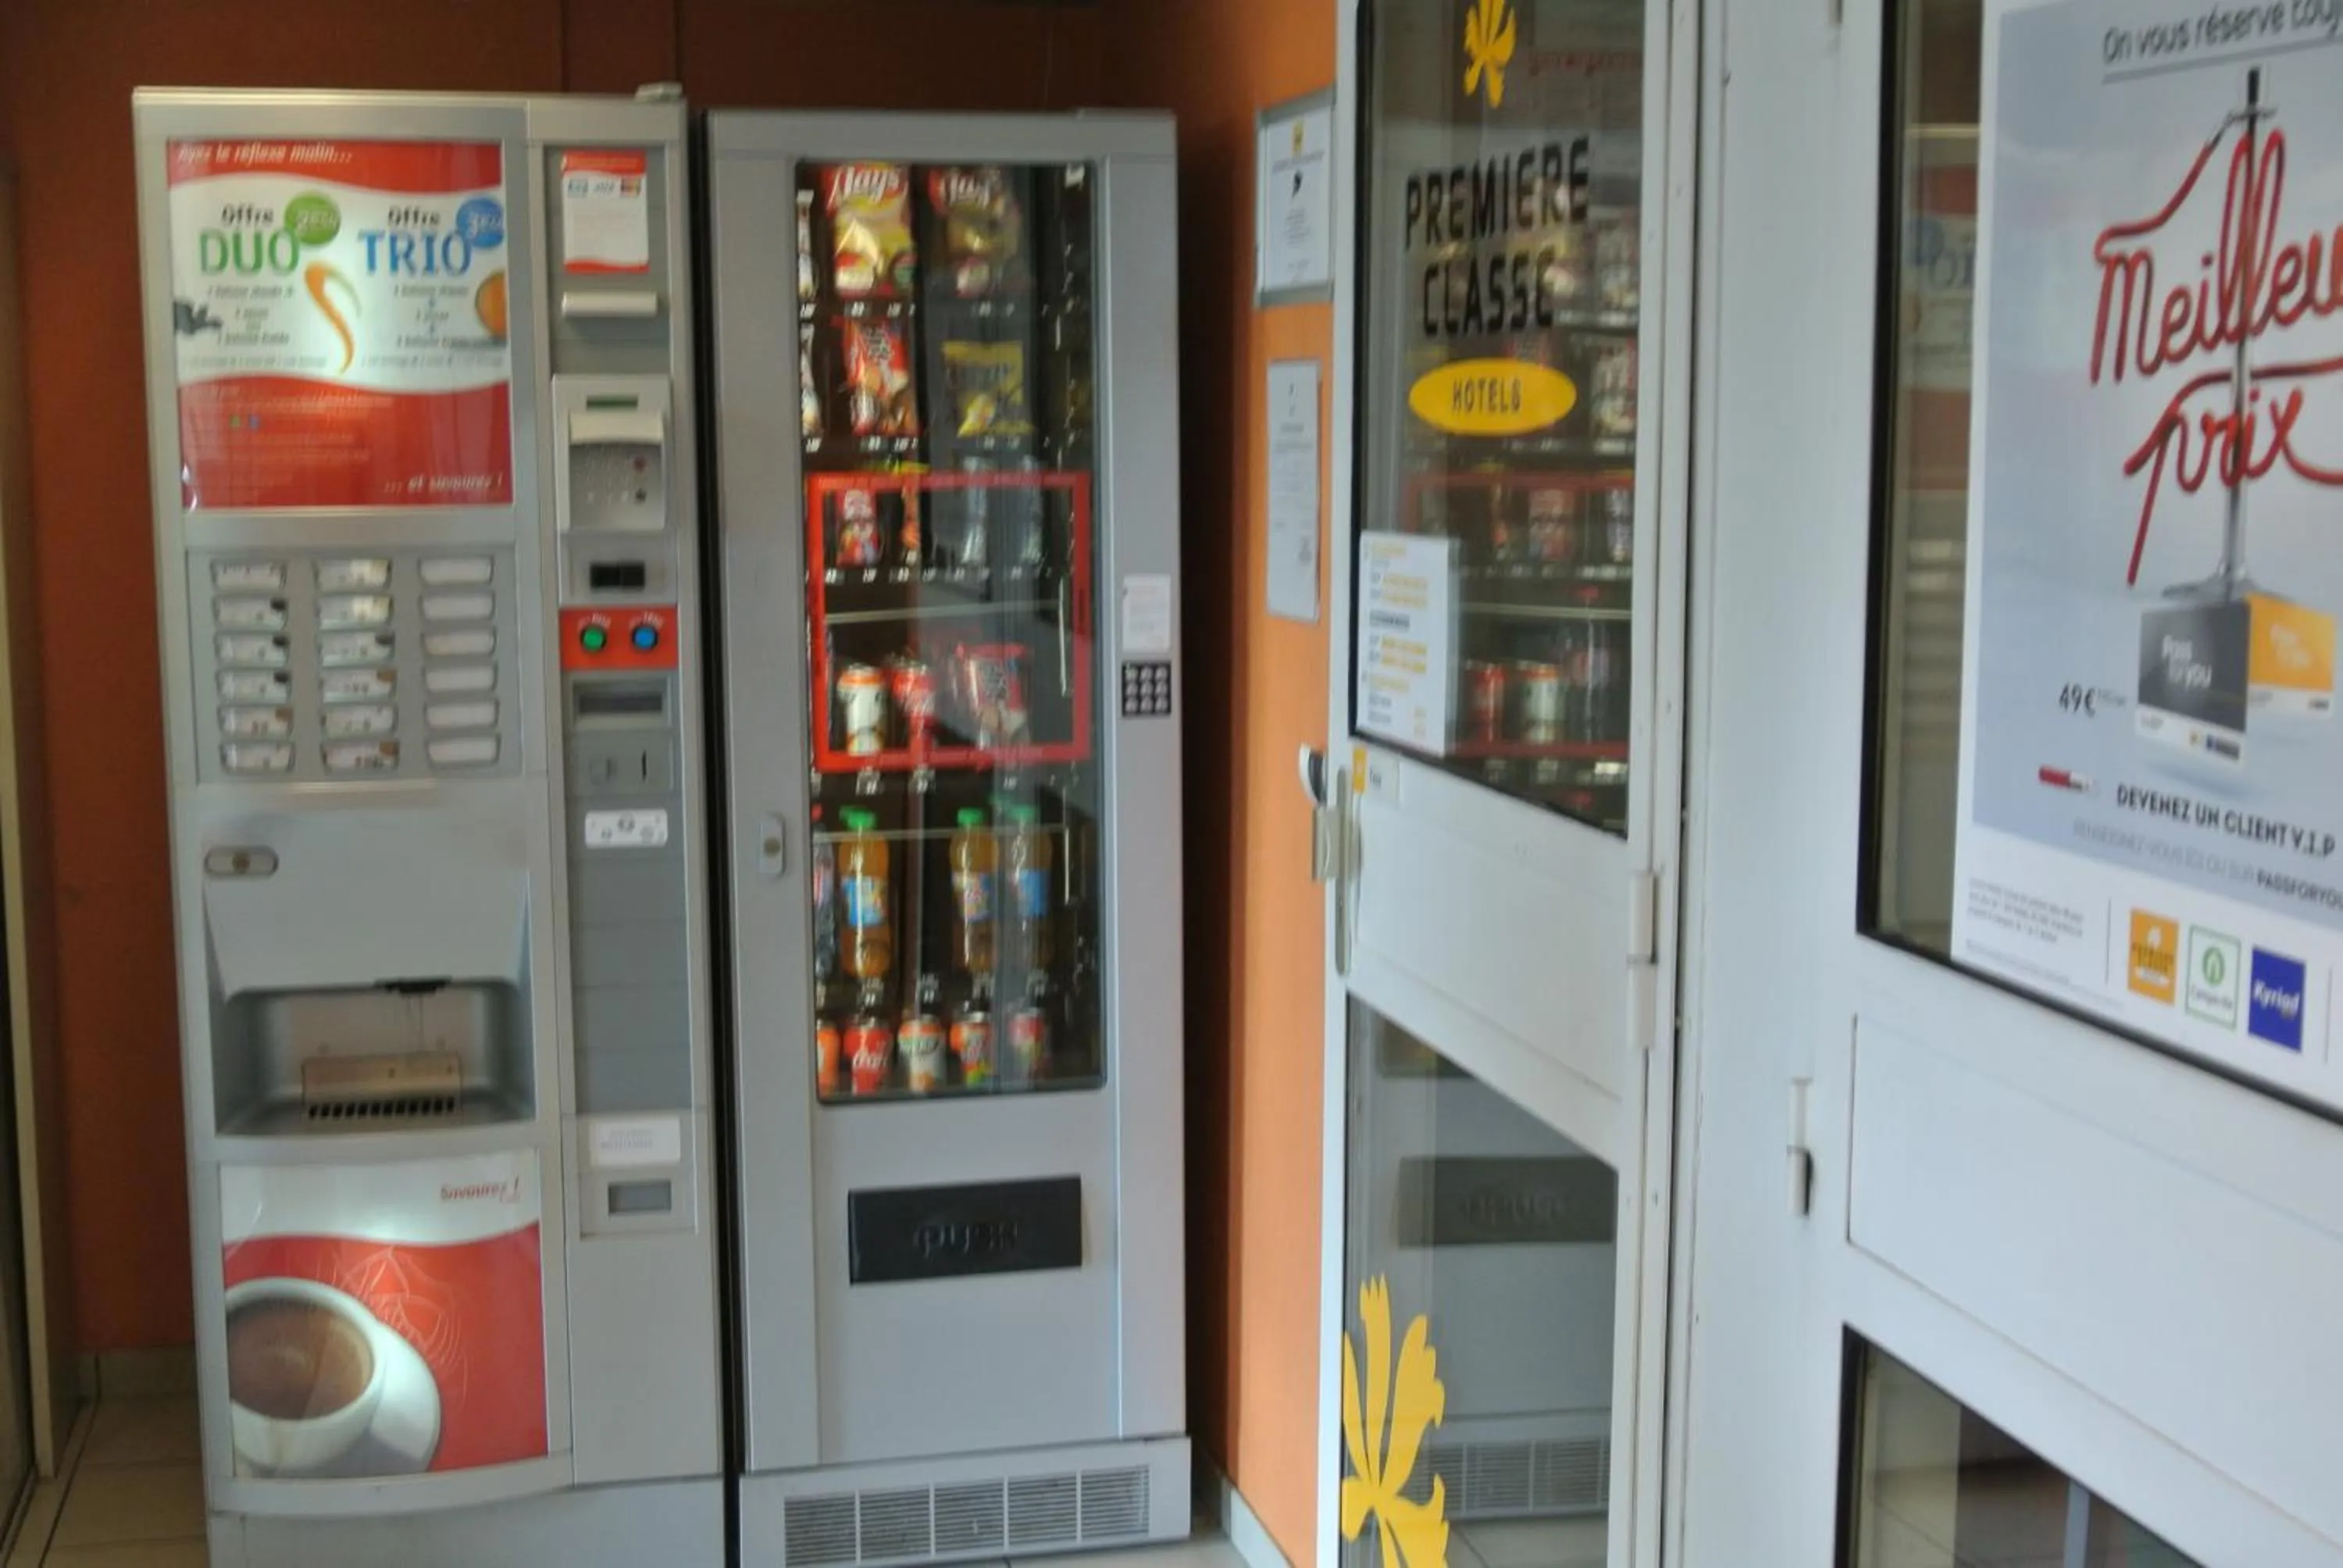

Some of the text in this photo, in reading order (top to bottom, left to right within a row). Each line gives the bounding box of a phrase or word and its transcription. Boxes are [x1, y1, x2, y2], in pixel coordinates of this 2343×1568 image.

[2104, 26, 2132, 64] On
[2138, 19, 2189, 59] vous
[1406, 134, 1590, 252] PREMIERE
[199, 230, 301, 276] DUO
[358, 228, 473, 277] TRIO
[1423, 246, 1556, 340] CLASSE
[1452, 378, 1522, 415] HOTELS
[2059, 682, 2096, 718] 49€
[2117, 781, 2190, 824] DEVENEZ
[2195, 801, 2220, 829] UN
[2224, 809, 2288, 847] CLIENT
[2254, 978, 2301, 1019] Kyriad
